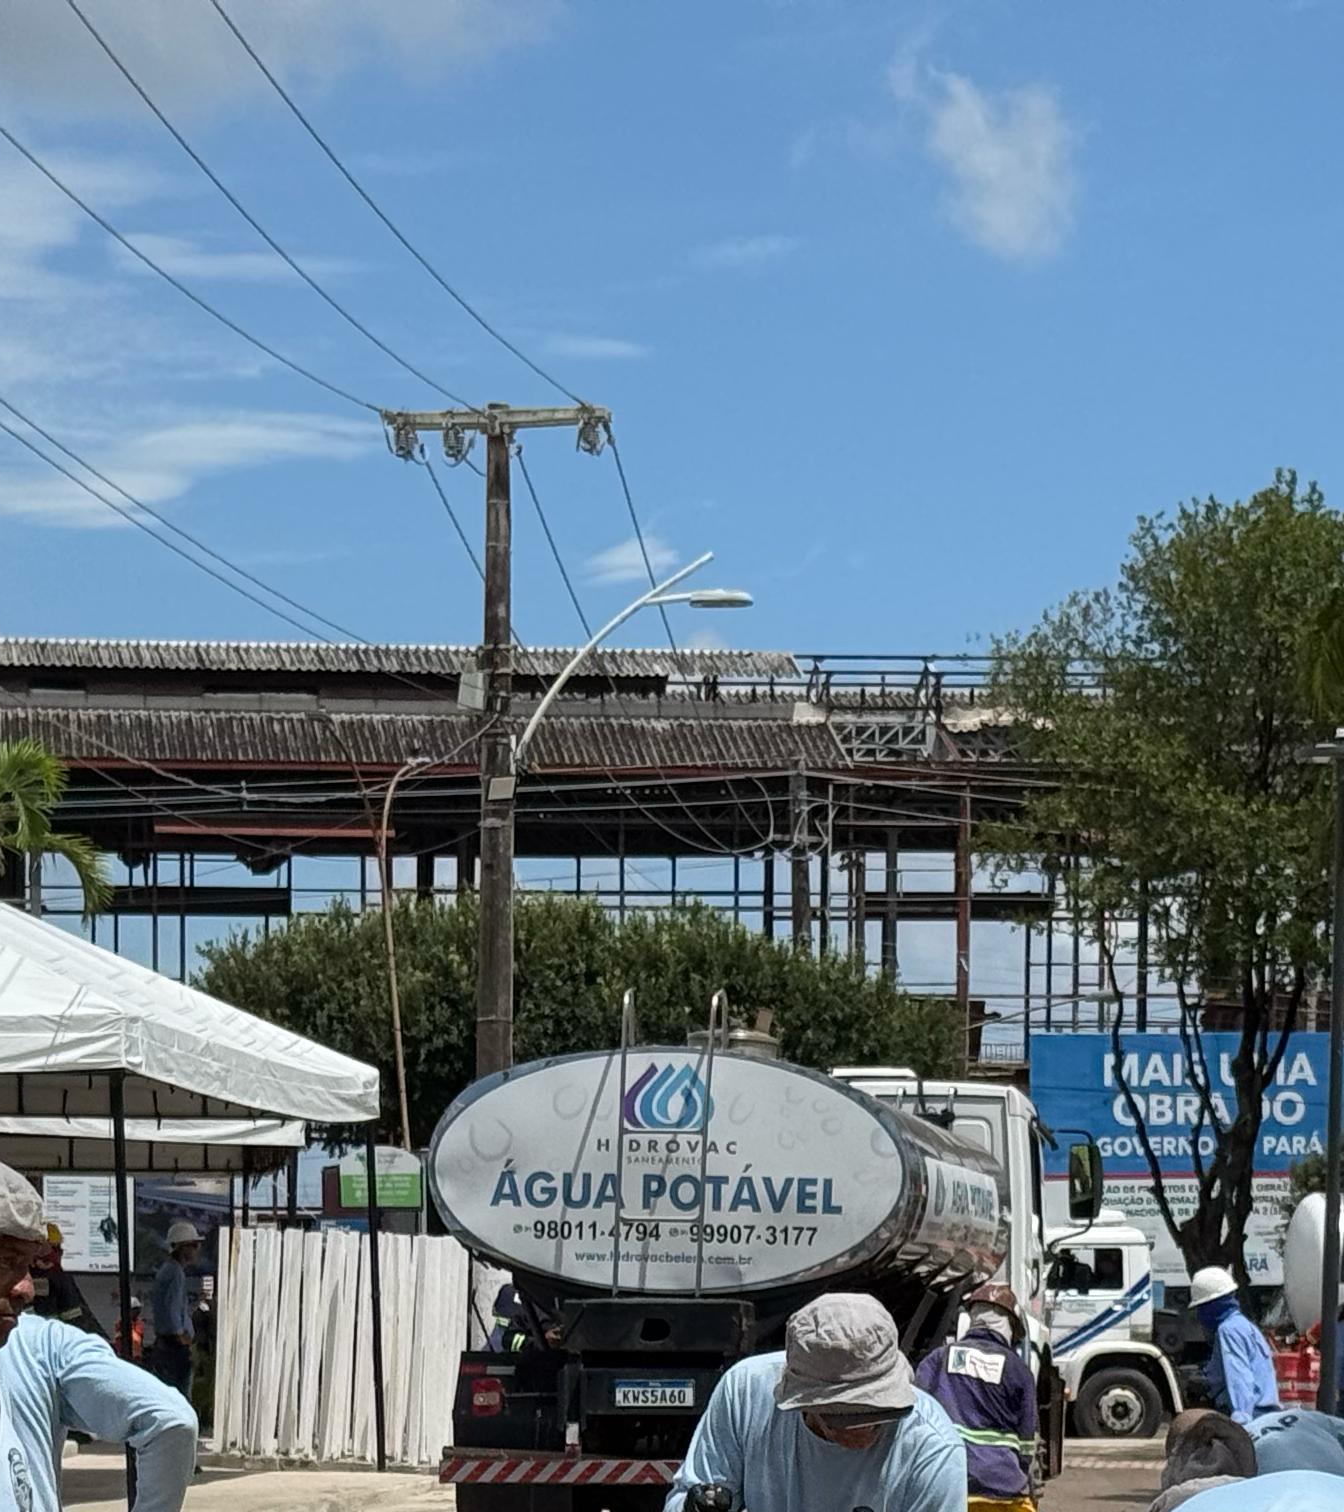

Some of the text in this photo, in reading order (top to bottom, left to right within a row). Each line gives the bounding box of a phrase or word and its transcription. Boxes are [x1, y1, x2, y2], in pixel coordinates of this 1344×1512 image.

[1103, 1052, 1205, 1088] MAIS
[1112, 1092, 1231, 1127] OBRA
[596, 1138, 738, 1156] HDROVAC
[1096, 1130, 1324, 1158] GOVERNO PARÁ
[490, 1158, 844, 1215] ÁGUA POTÁVEL
[622, 1388, 687, 1405] KWS5A60
